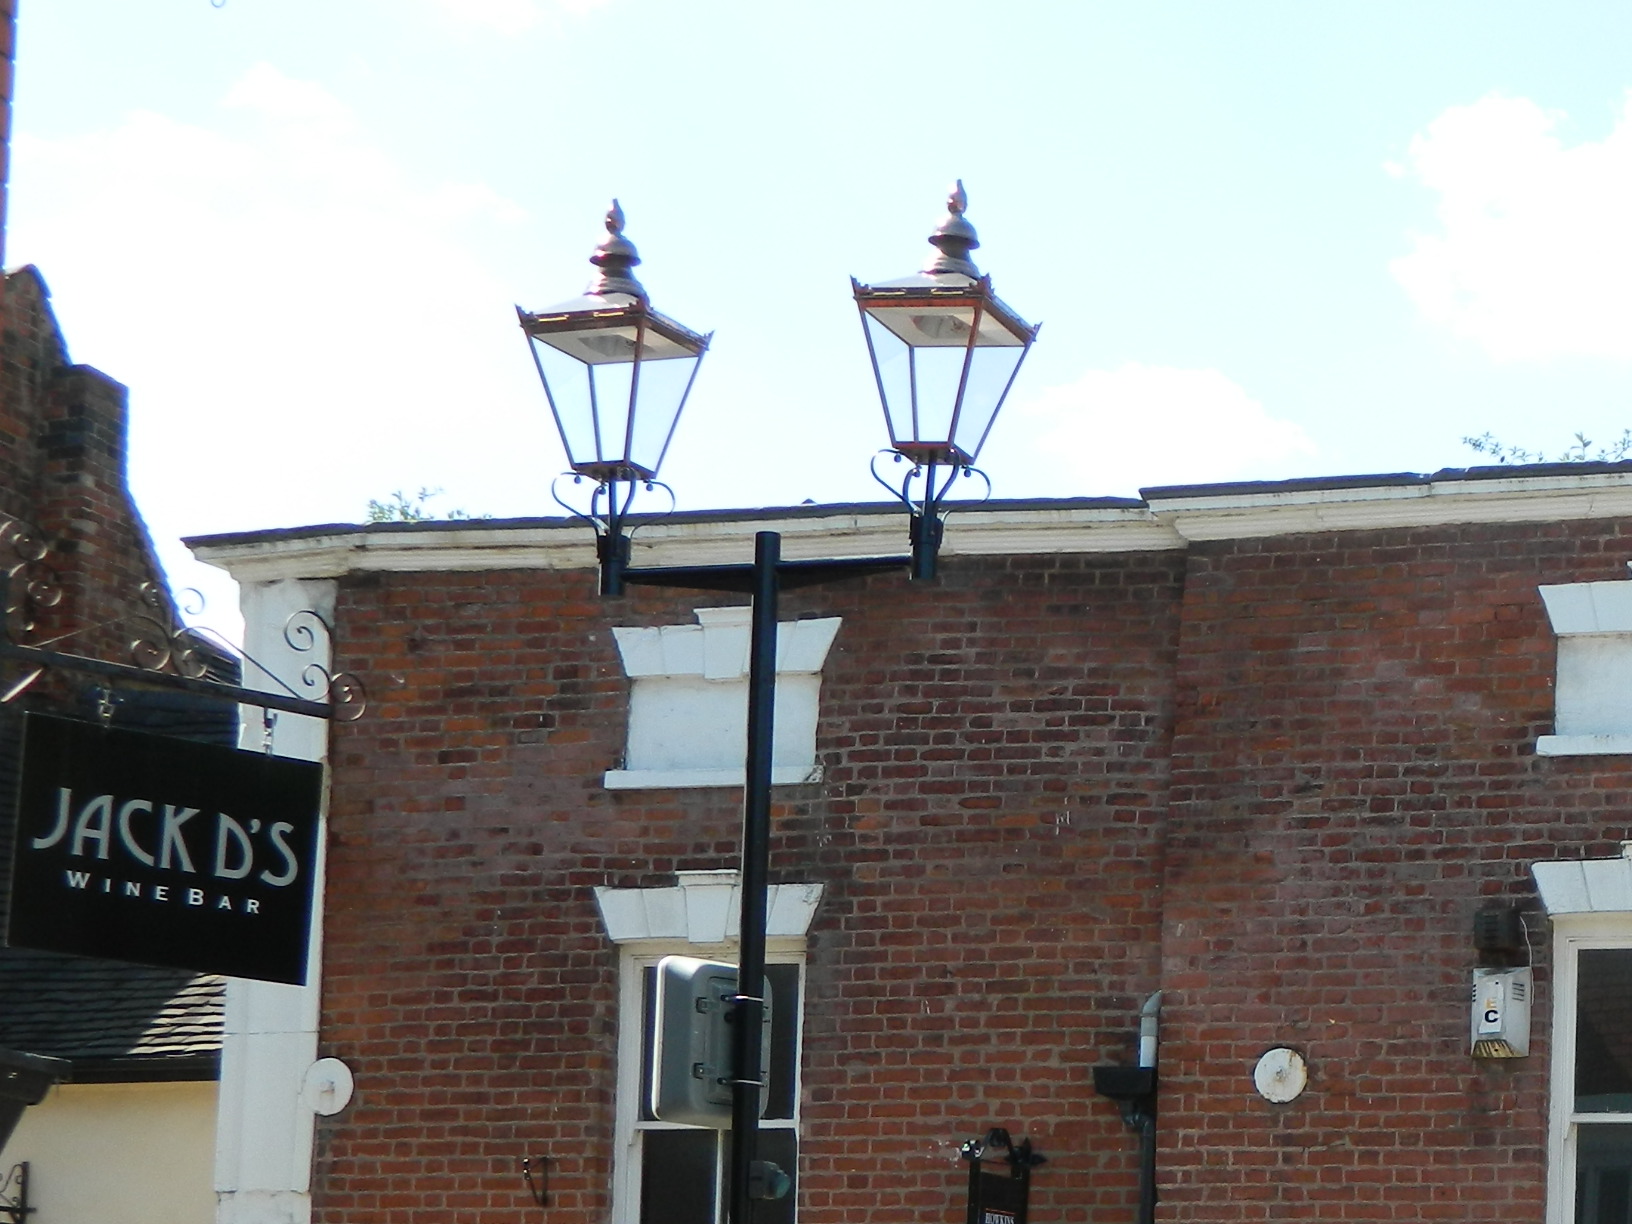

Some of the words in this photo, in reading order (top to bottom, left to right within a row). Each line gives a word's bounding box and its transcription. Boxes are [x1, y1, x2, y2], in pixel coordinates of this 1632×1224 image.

[31, 786, 201, 876] JACK
[212, 812, 299, 887] D'S
[66, 869, 169, 902] WINE
[186, 887, 261, 916] BAR
